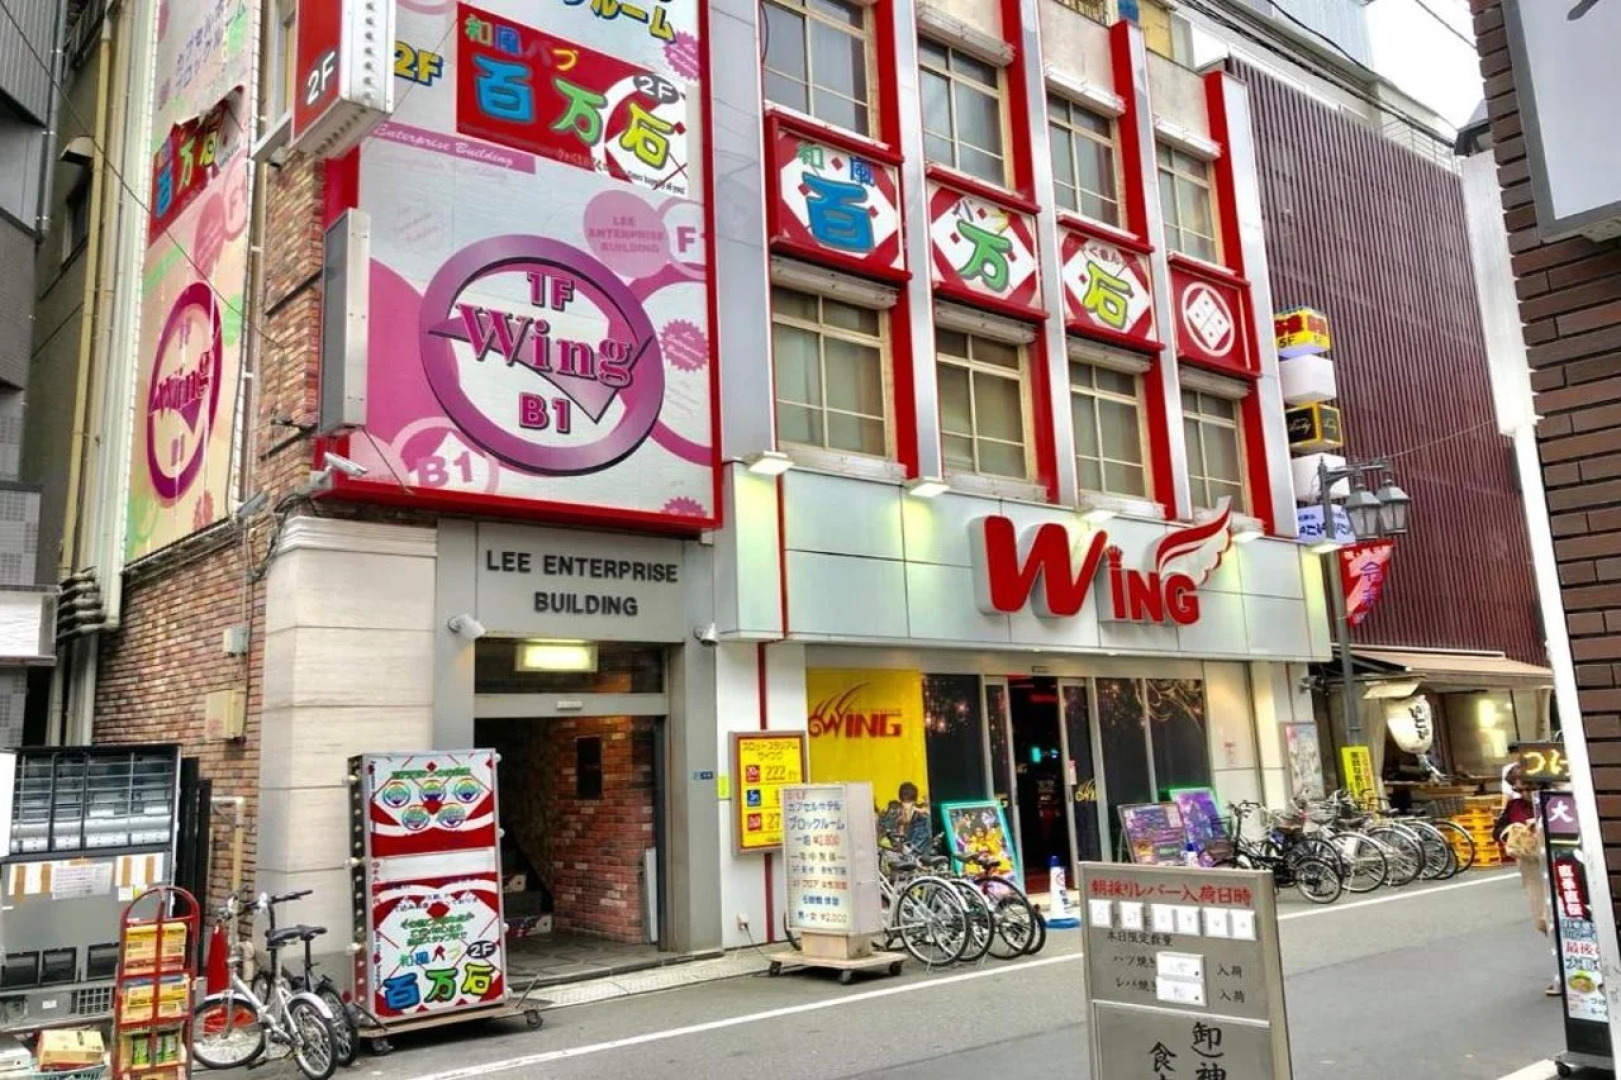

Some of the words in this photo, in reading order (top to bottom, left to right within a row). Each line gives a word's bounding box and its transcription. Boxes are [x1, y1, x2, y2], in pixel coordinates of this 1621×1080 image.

[306, 51, 335, 106] 2F
[393, 38, 442, 86] 2F
[636, 75, 676, 100] 2F
[472, 54, 676, 171] 百万石
[527, 272, 575, 312] 1F
[455, 303, 633, 388] Wing
[518, 392, 572, 435] B1
[416, 450, 473, 487] B1
[486, 550, 531, 572] LEE
[543, 555, 678, 583] ENTERPRISE
[534, 592, 638, 616] BUILDING
[383, 963, 496, 1010] 百万石
